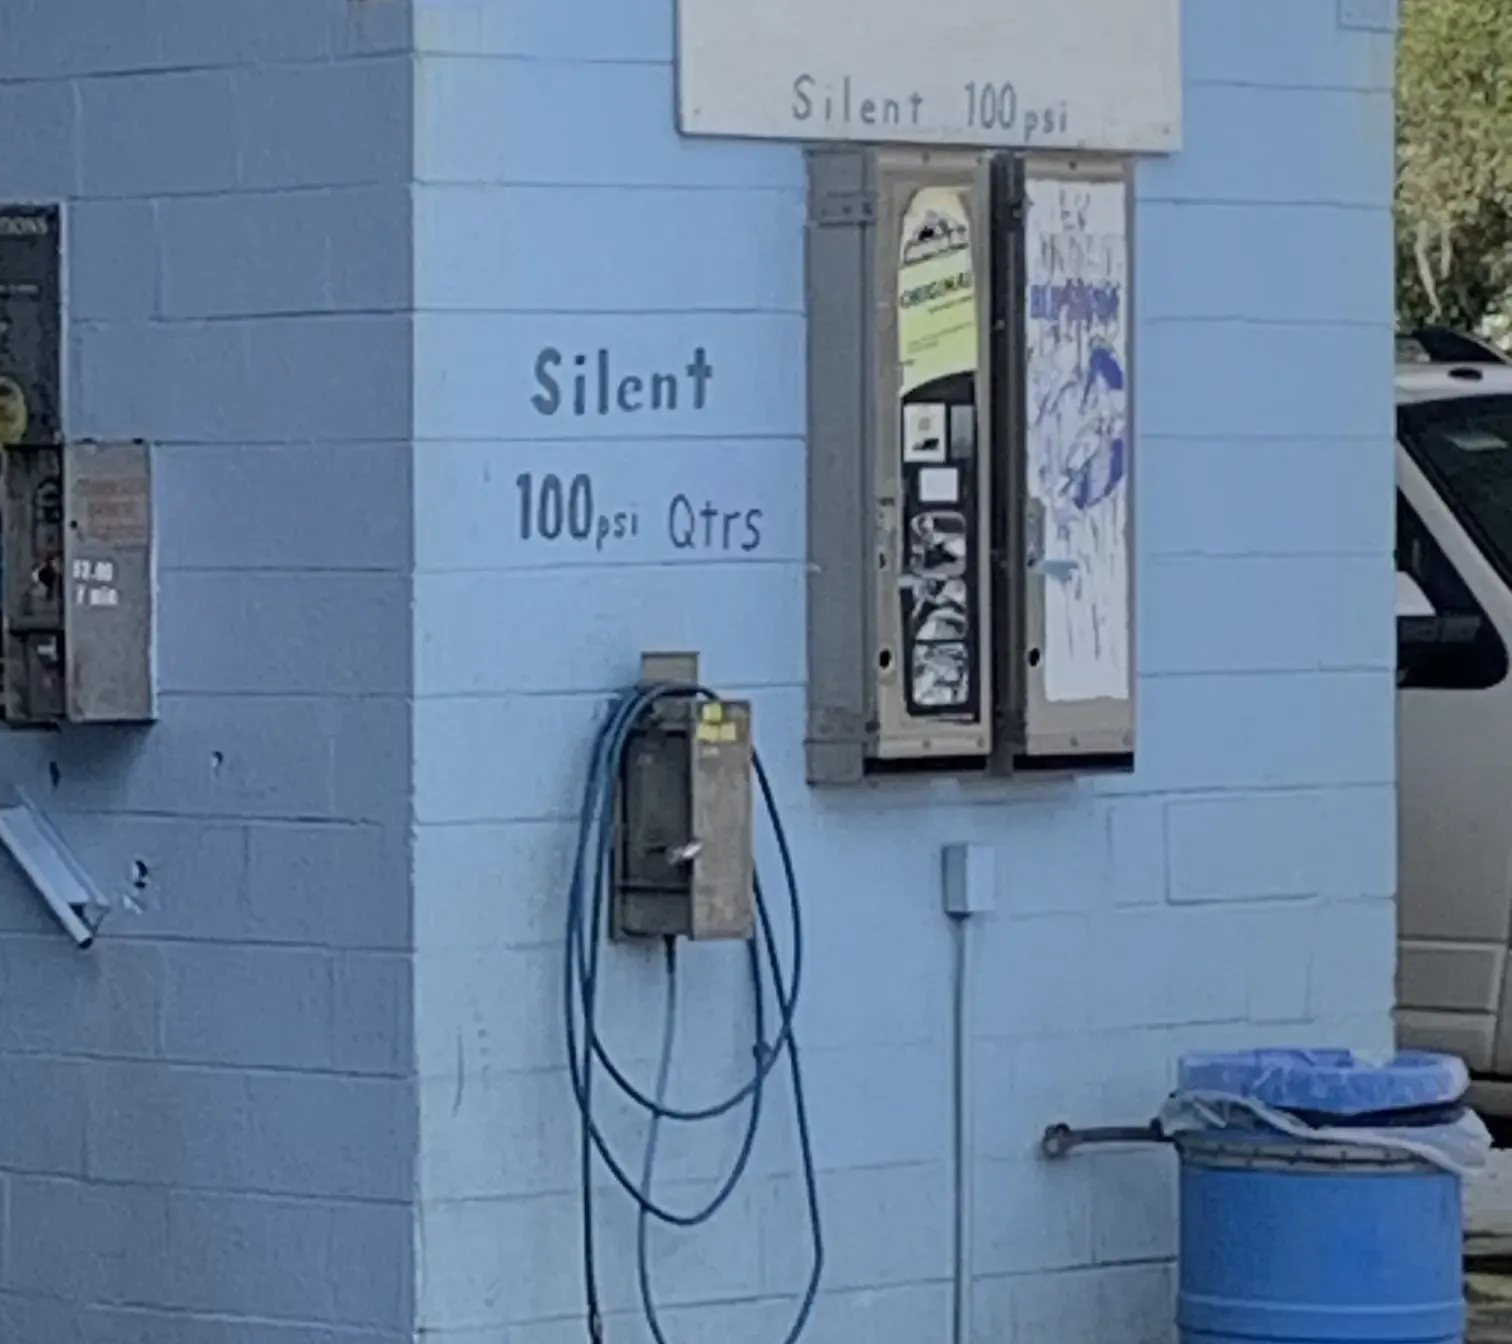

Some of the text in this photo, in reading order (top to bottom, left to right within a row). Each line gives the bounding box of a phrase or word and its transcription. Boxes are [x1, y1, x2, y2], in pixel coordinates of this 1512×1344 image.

[791, 73, 1069, 141] Silent 100psi
[530, 345, 713, 416] Silent
[515, 472, 764, 552] 100psi Qtrs
